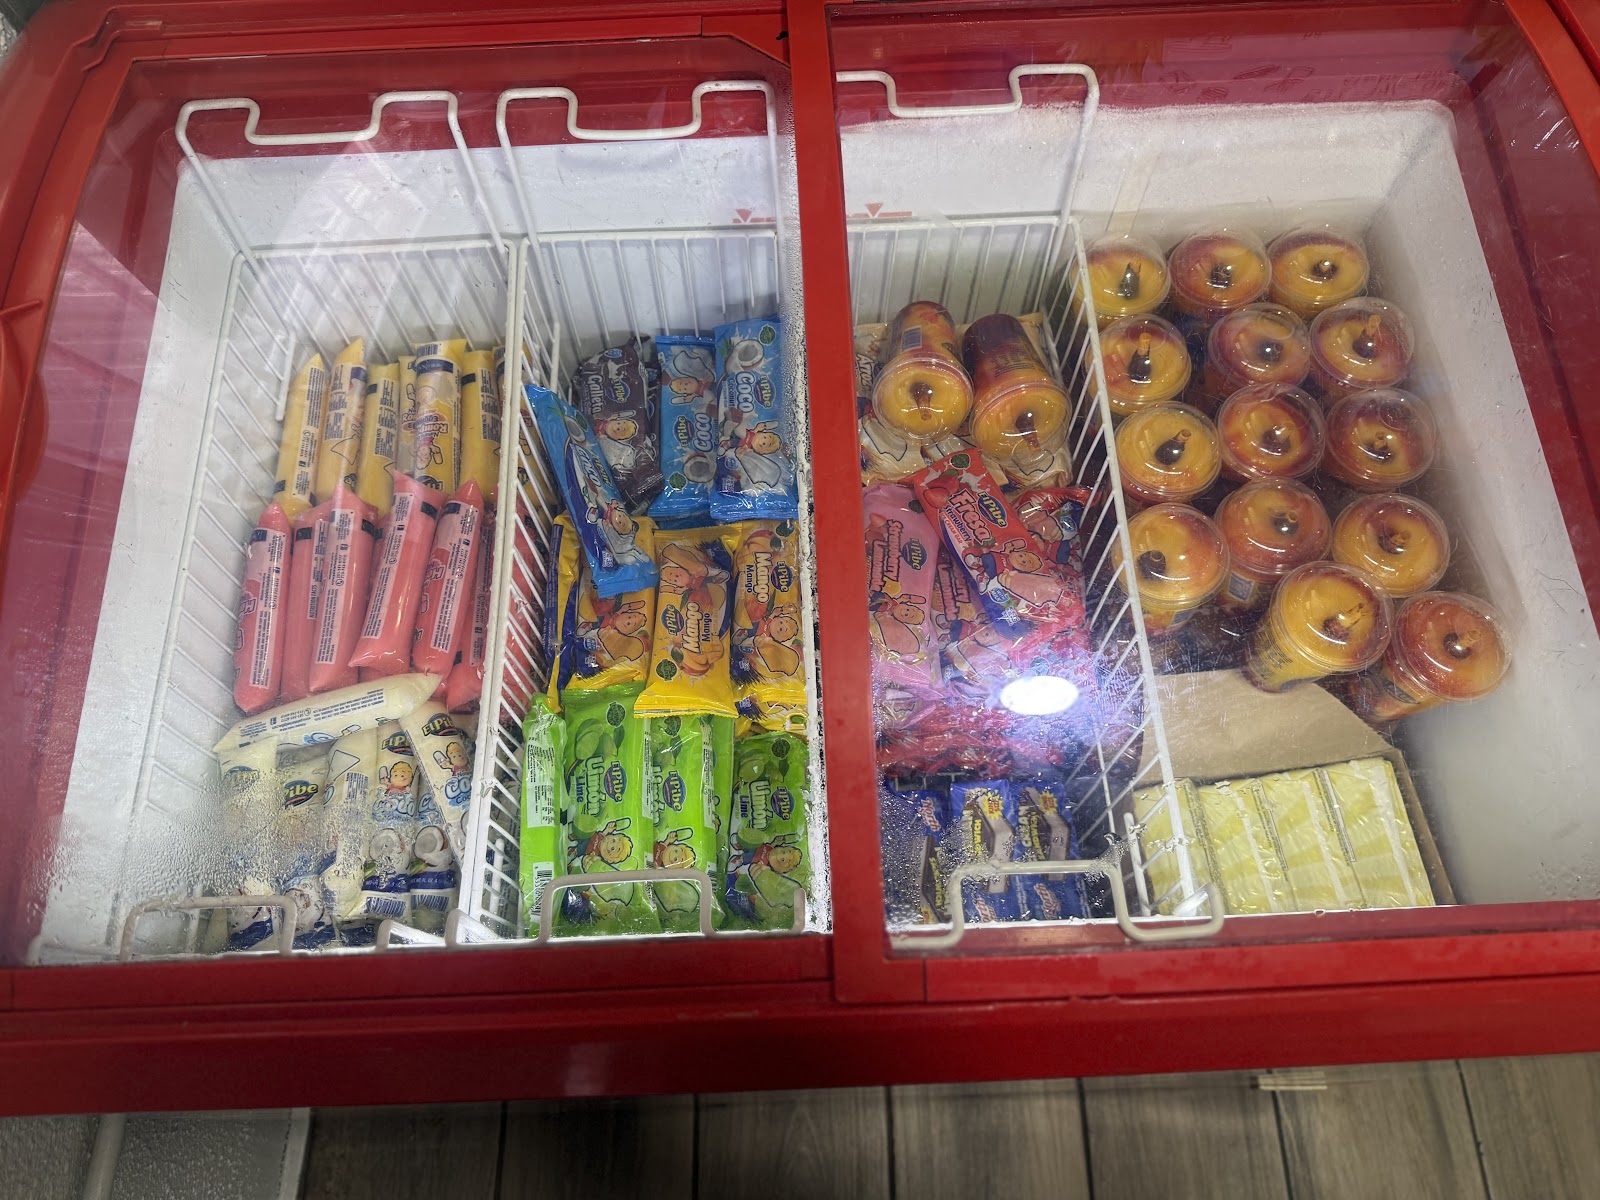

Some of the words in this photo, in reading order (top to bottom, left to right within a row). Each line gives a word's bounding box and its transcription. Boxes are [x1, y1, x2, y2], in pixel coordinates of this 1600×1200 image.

[856, 354, 873, 387] Arroz
[588, 374, 603, 413] Galleta
[727, 379, 736, 408] Coconut
[943, 504, 972, 544] Strawberry
[944, 519, 956, 534] CREAM
[949, 488, 992, 545] Fresa
[885, 521, 902, 581] Strawberry
[744, 564, 756, 593] Mango
[753, 551, 771, 603] Mango
[682, 601, 704, 654] Mango
[702, 613, 712, 641] Mango
[575, 776, 588, 803] Lime
[585, 754, 606, 815] Limón
[739, 795, 751, 818] Lime
[749, 780, 769, 830] Limón
[921, 799, 939, 832] North
